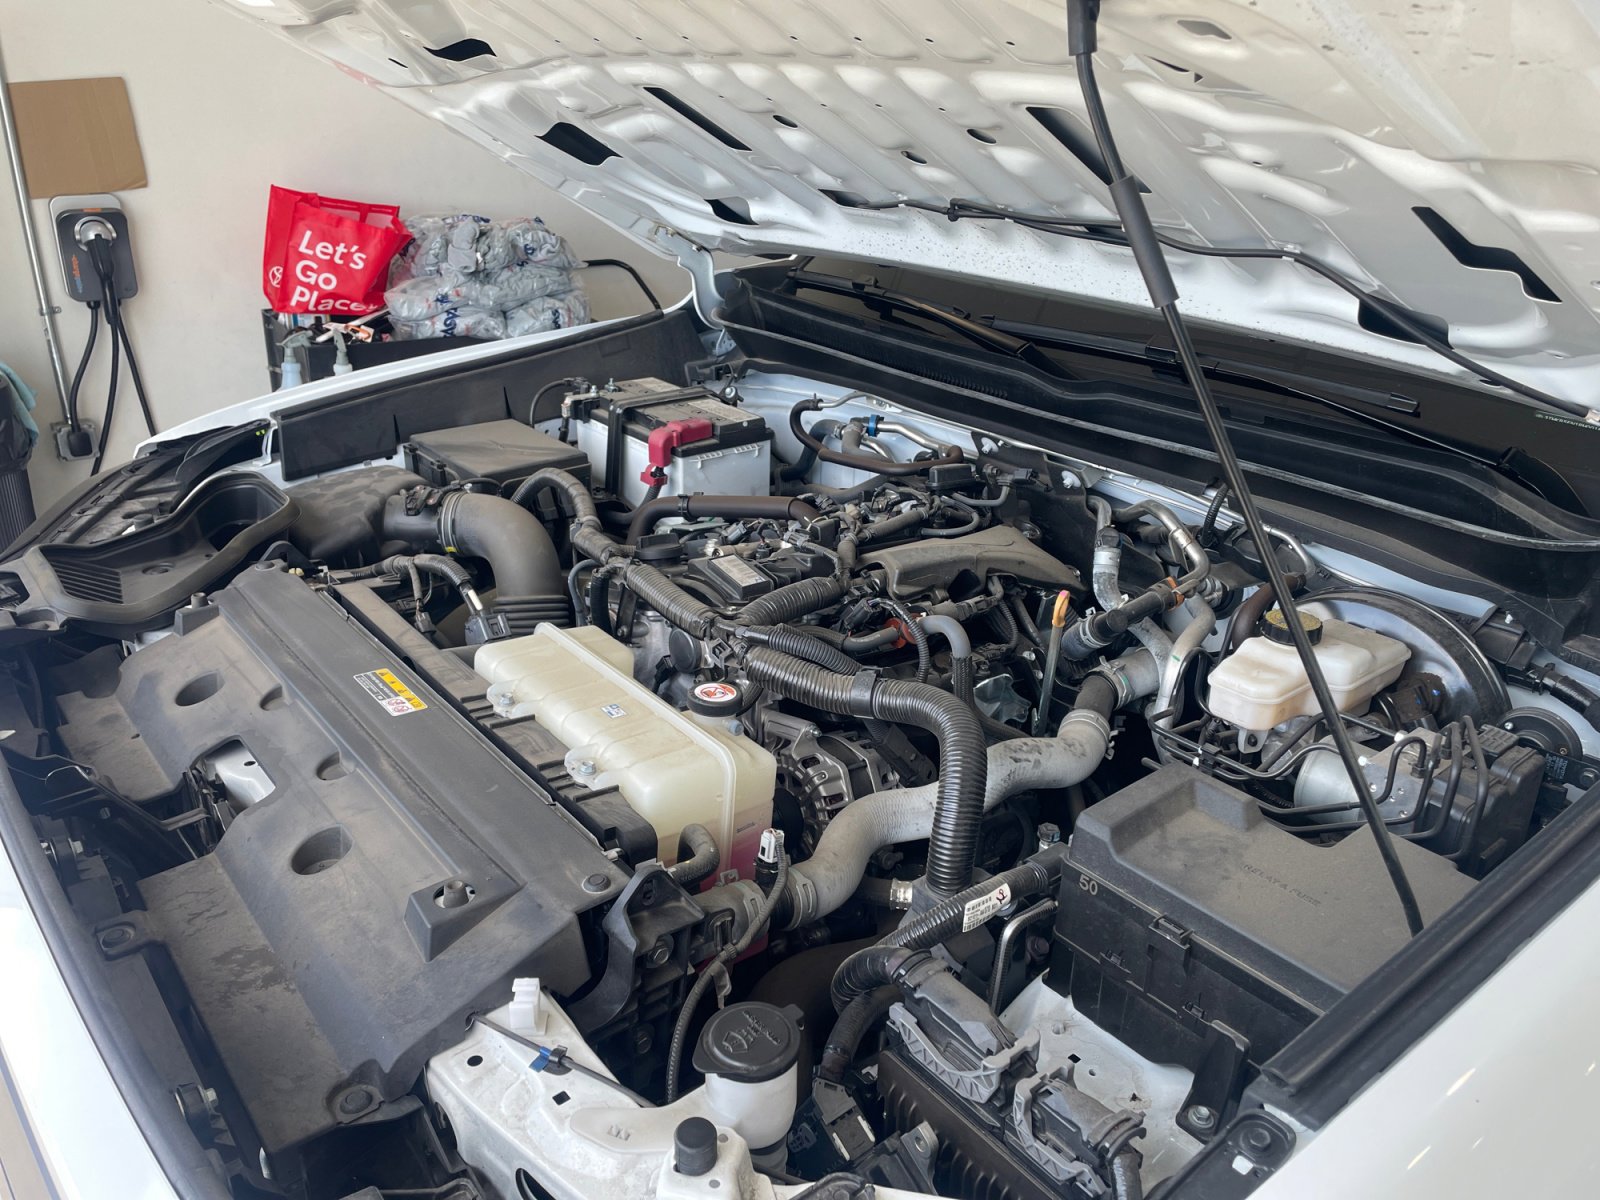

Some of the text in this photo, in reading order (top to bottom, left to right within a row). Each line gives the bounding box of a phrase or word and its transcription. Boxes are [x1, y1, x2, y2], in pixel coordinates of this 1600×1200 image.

[298, 230, 367, 270] Let's
[295, 259, 338, 291] Go
[1079, 873, 1098, 896] 50
[1289, 888, 1321, 906] FUSE
